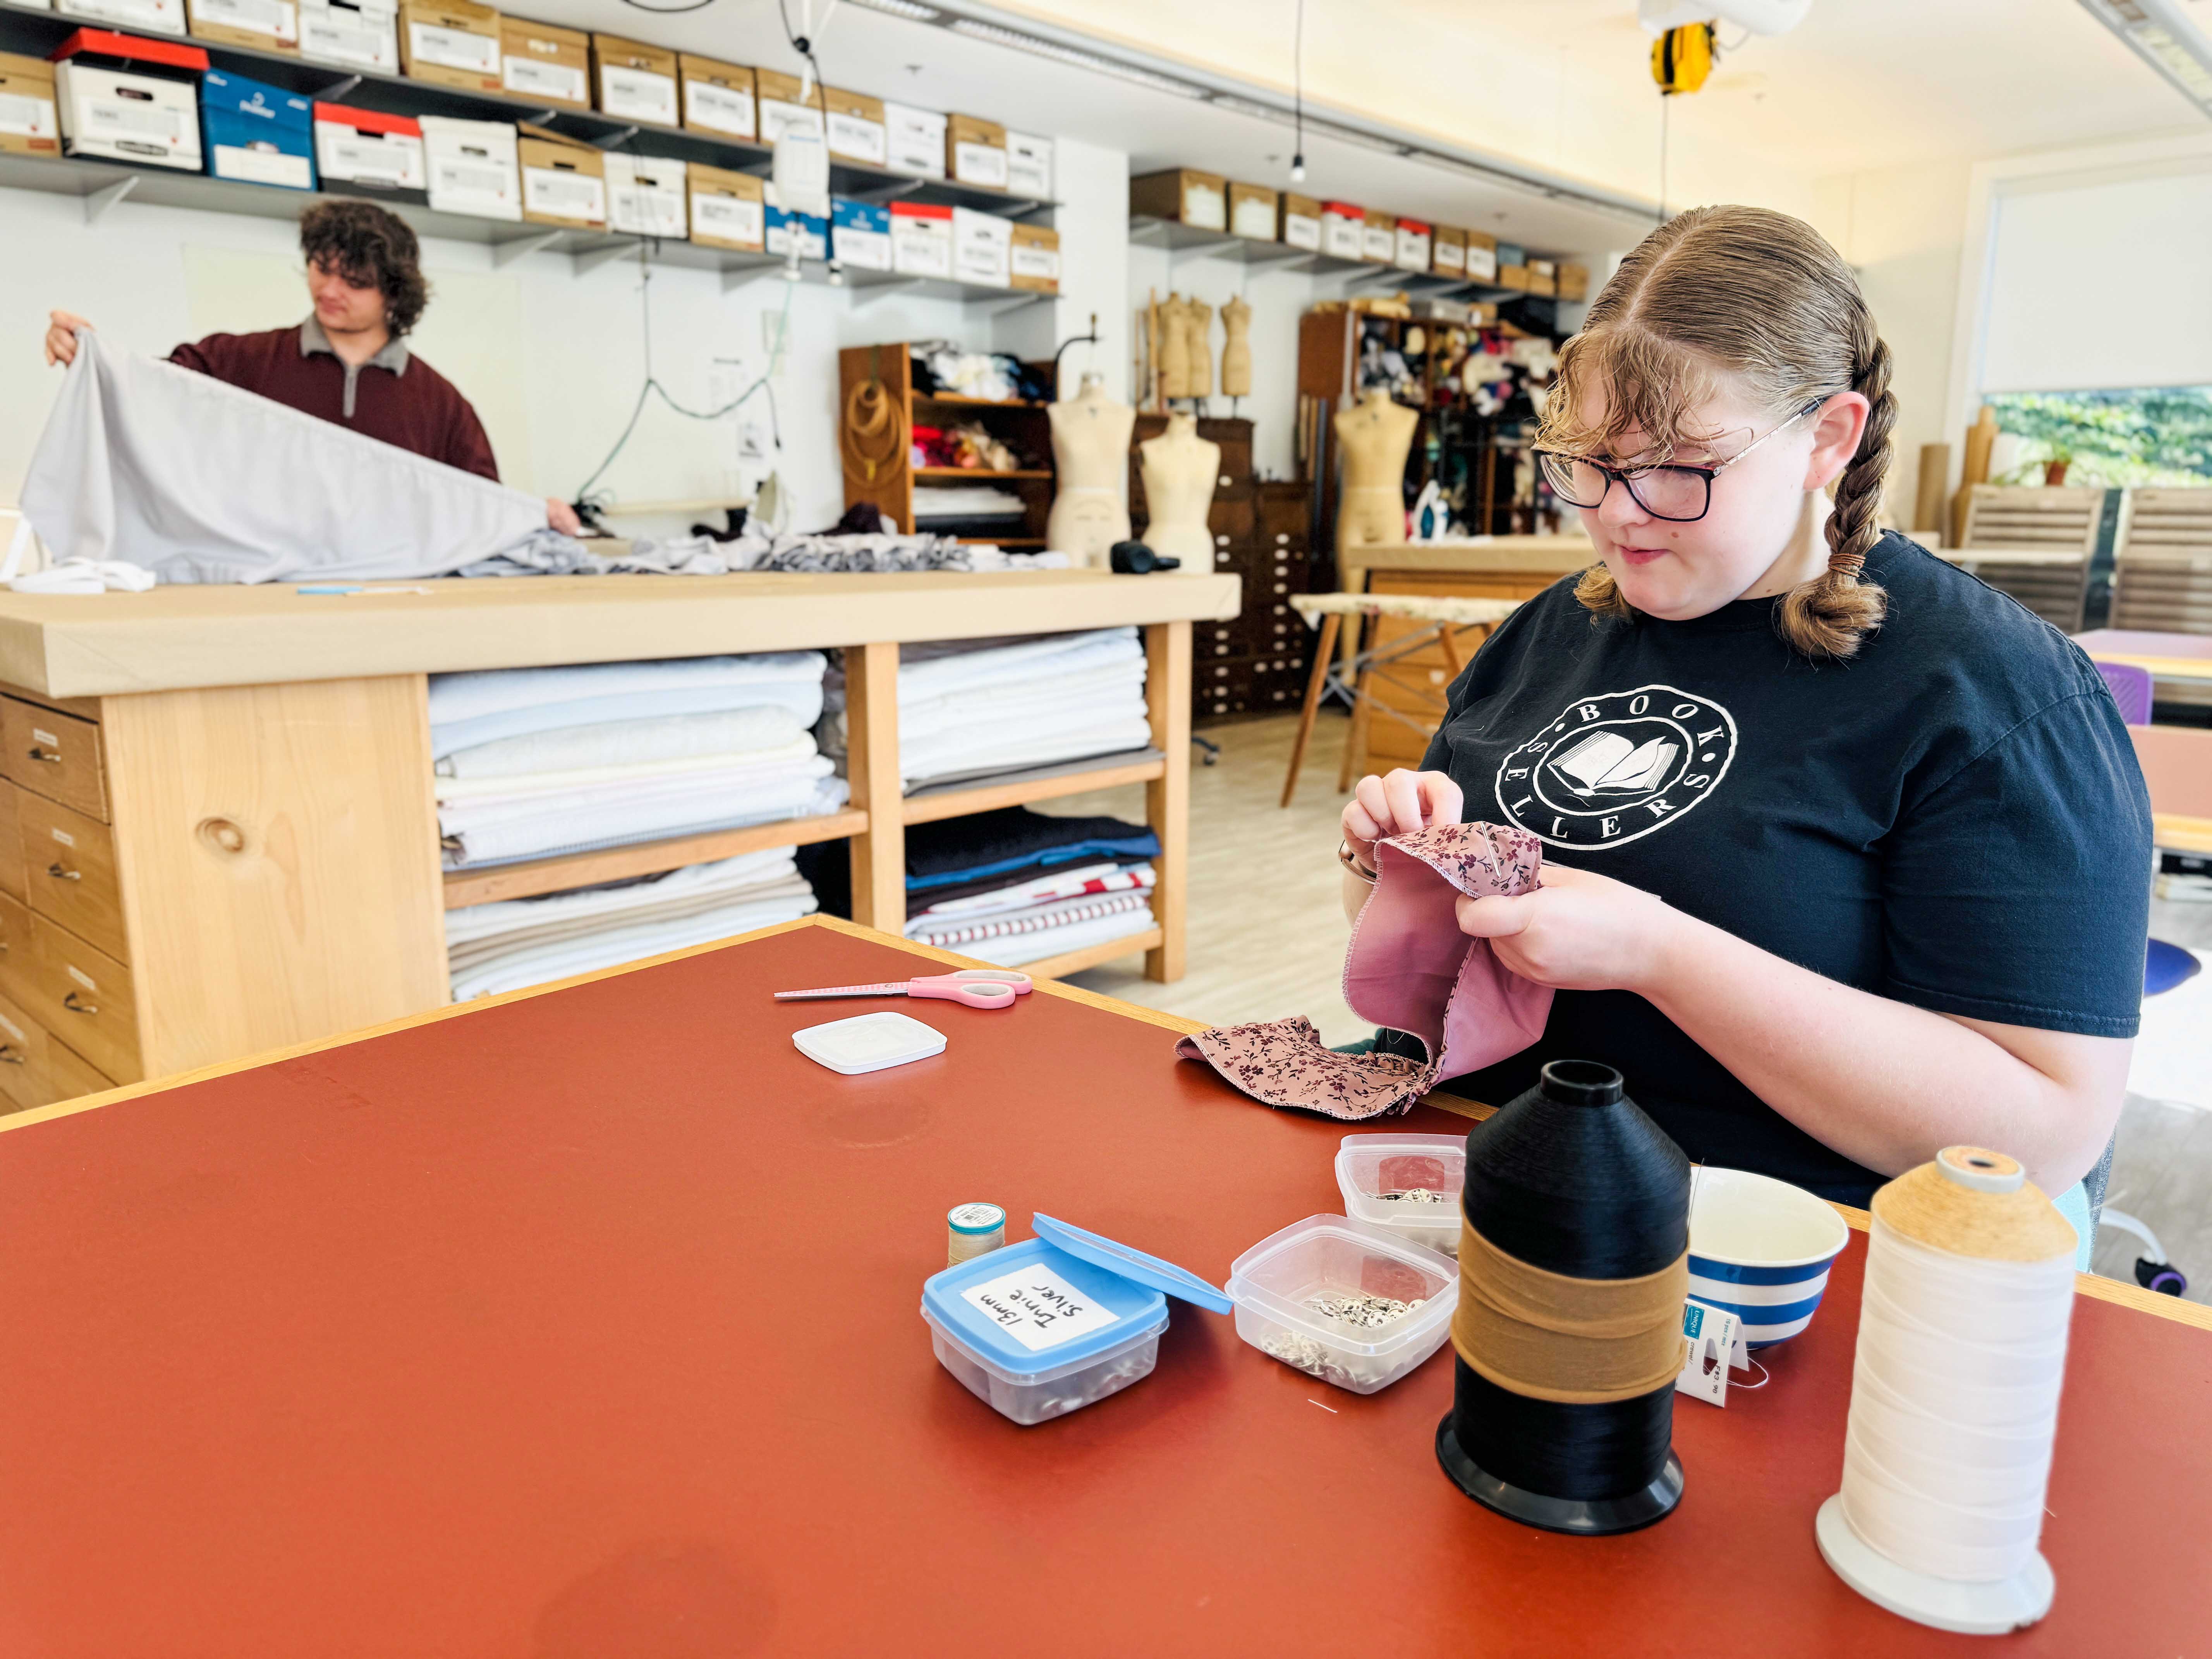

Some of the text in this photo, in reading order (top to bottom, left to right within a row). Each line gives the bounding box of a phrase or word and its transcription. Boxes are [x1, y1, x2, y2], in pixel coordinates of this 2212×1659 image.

[1505, 695, 1725, 839] BOOK SELLERS
[980, 1294, 1023, 1326] 13mm
[1009, 1289, 1057, 1329] Innie
[1690, 1310, 1700, 1333] UNIQUE
